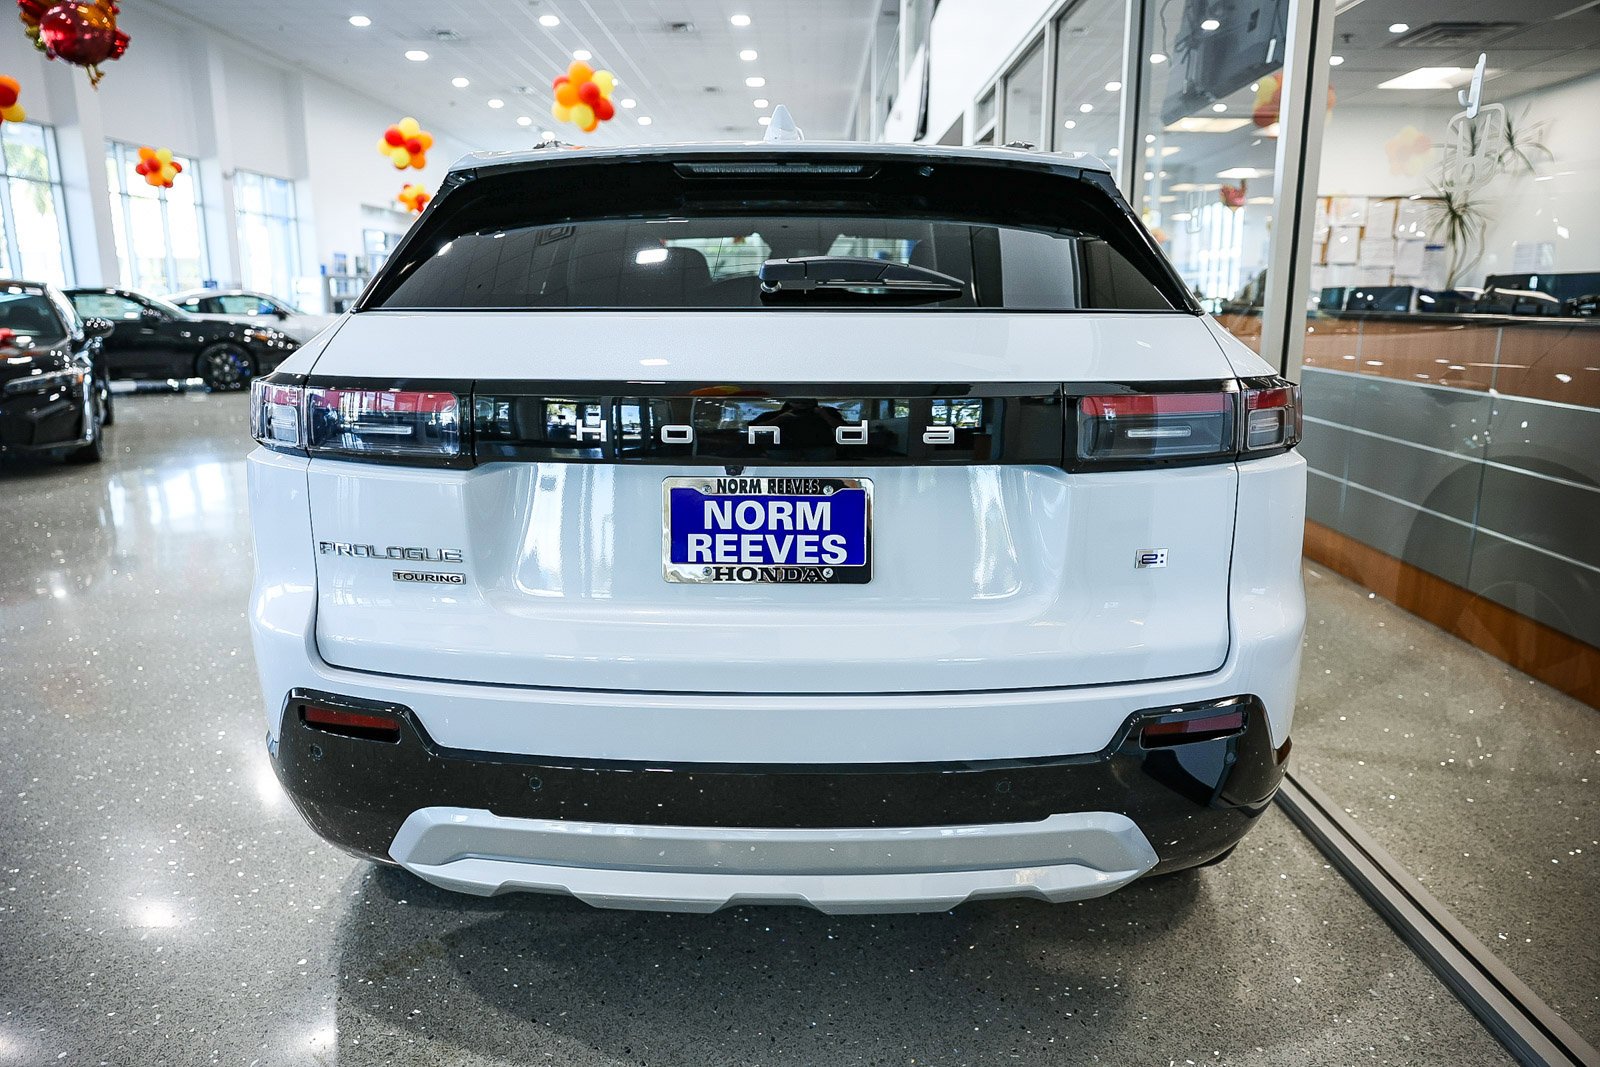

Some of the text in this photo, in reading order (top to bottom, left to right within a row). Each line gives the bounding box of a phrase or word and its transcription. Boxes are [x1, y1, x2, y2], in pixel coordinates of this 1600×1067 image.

[576, 419, 955, 445] Honda
[716, 479, 820, 494] NORM REEVES
[704, 500, 831, 531] NORM
[319, 541, 463, 563] PROLOGUE
[687, 533, 848, 564] REEVES
[394, 572, 462, 584] TOURING
[712, 566, 828, 582] HONDA
